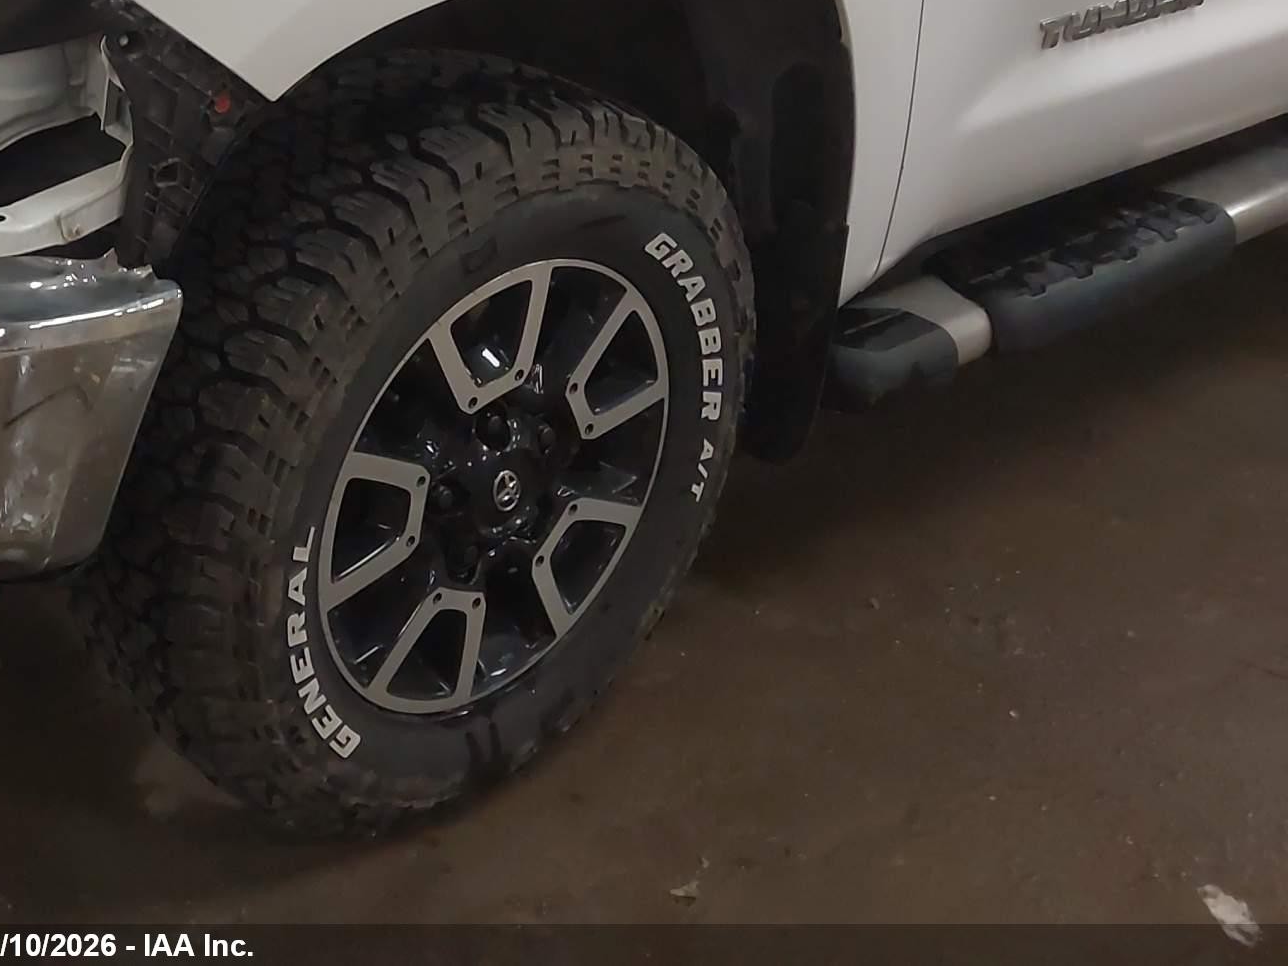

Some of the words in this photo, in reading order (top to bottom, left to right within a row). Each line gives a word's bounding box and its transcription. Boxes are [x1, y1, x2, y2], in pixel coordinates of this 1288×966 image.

[644, 233, 724, 422] GRABBER
[690, 438, 714, 503] A/T
[287, 526, 361, 759] GENERAL
